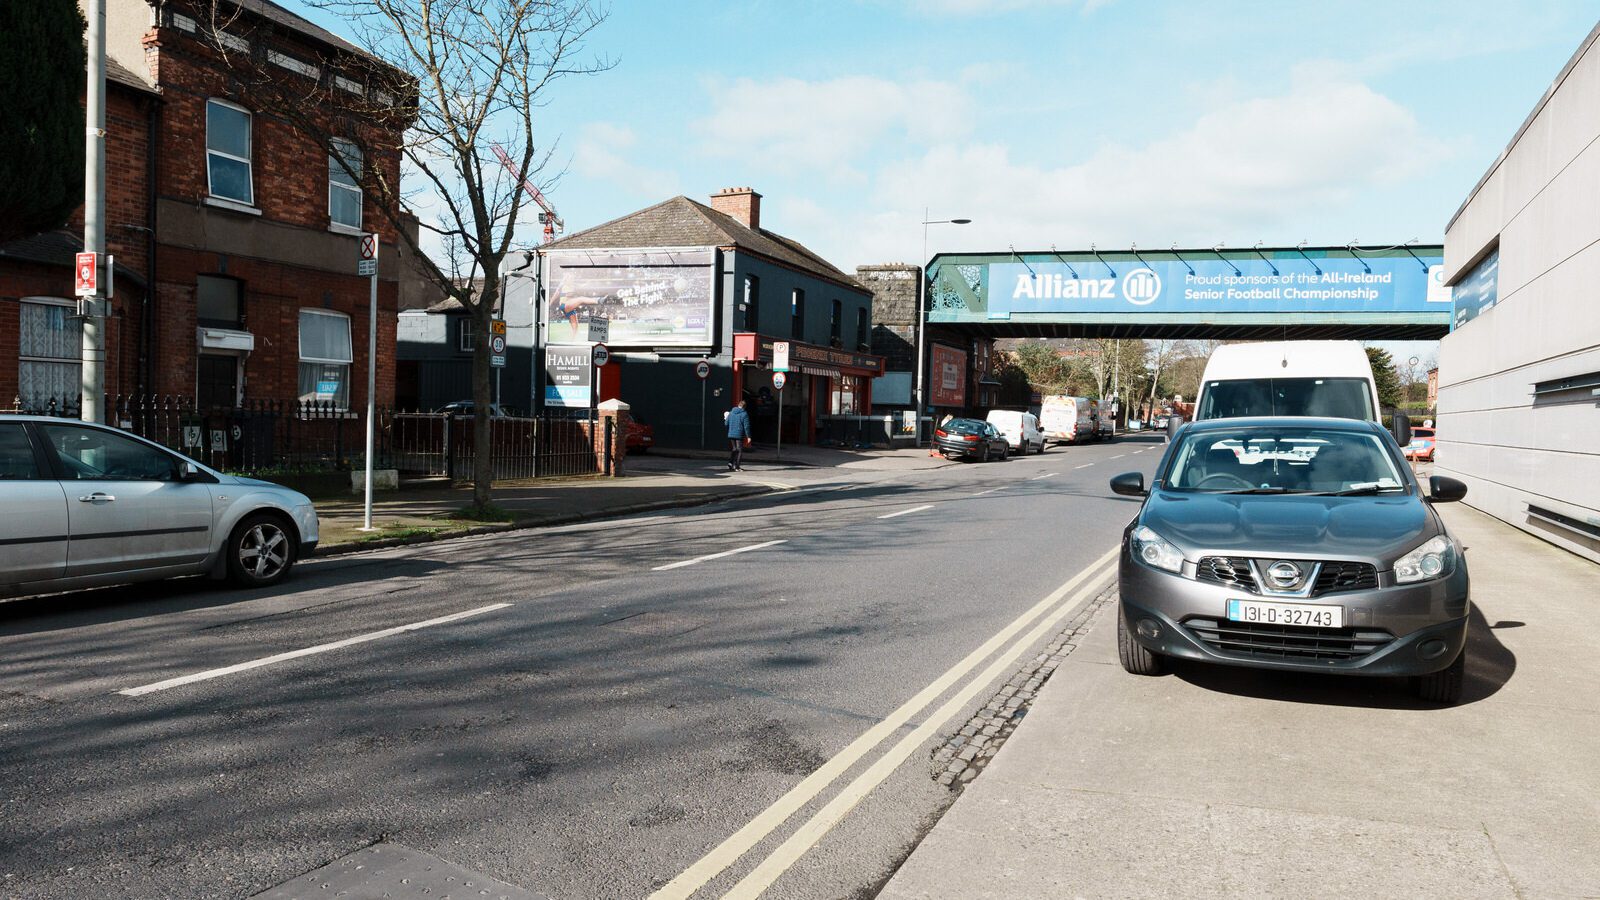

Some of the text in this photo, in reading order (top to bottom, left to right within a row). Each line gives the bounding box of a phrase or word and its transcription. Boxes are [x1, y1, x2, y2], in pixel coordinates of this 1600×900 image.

[1185, 271, 1392, 286] Proud sponsors of the All-Ireland
[1012, 273, 1116, 299] Allianz
[616, 288, 634, 299] Get
[622, 290, 663, 308] The Fight
[1184, 287, 1379, 301] Senior Football Championship
[590, 325, 607, 334] RAMPS
[547, 354, 590, 366] HAMILL
[1244, 606, 1332, 626] 131-D-32743
